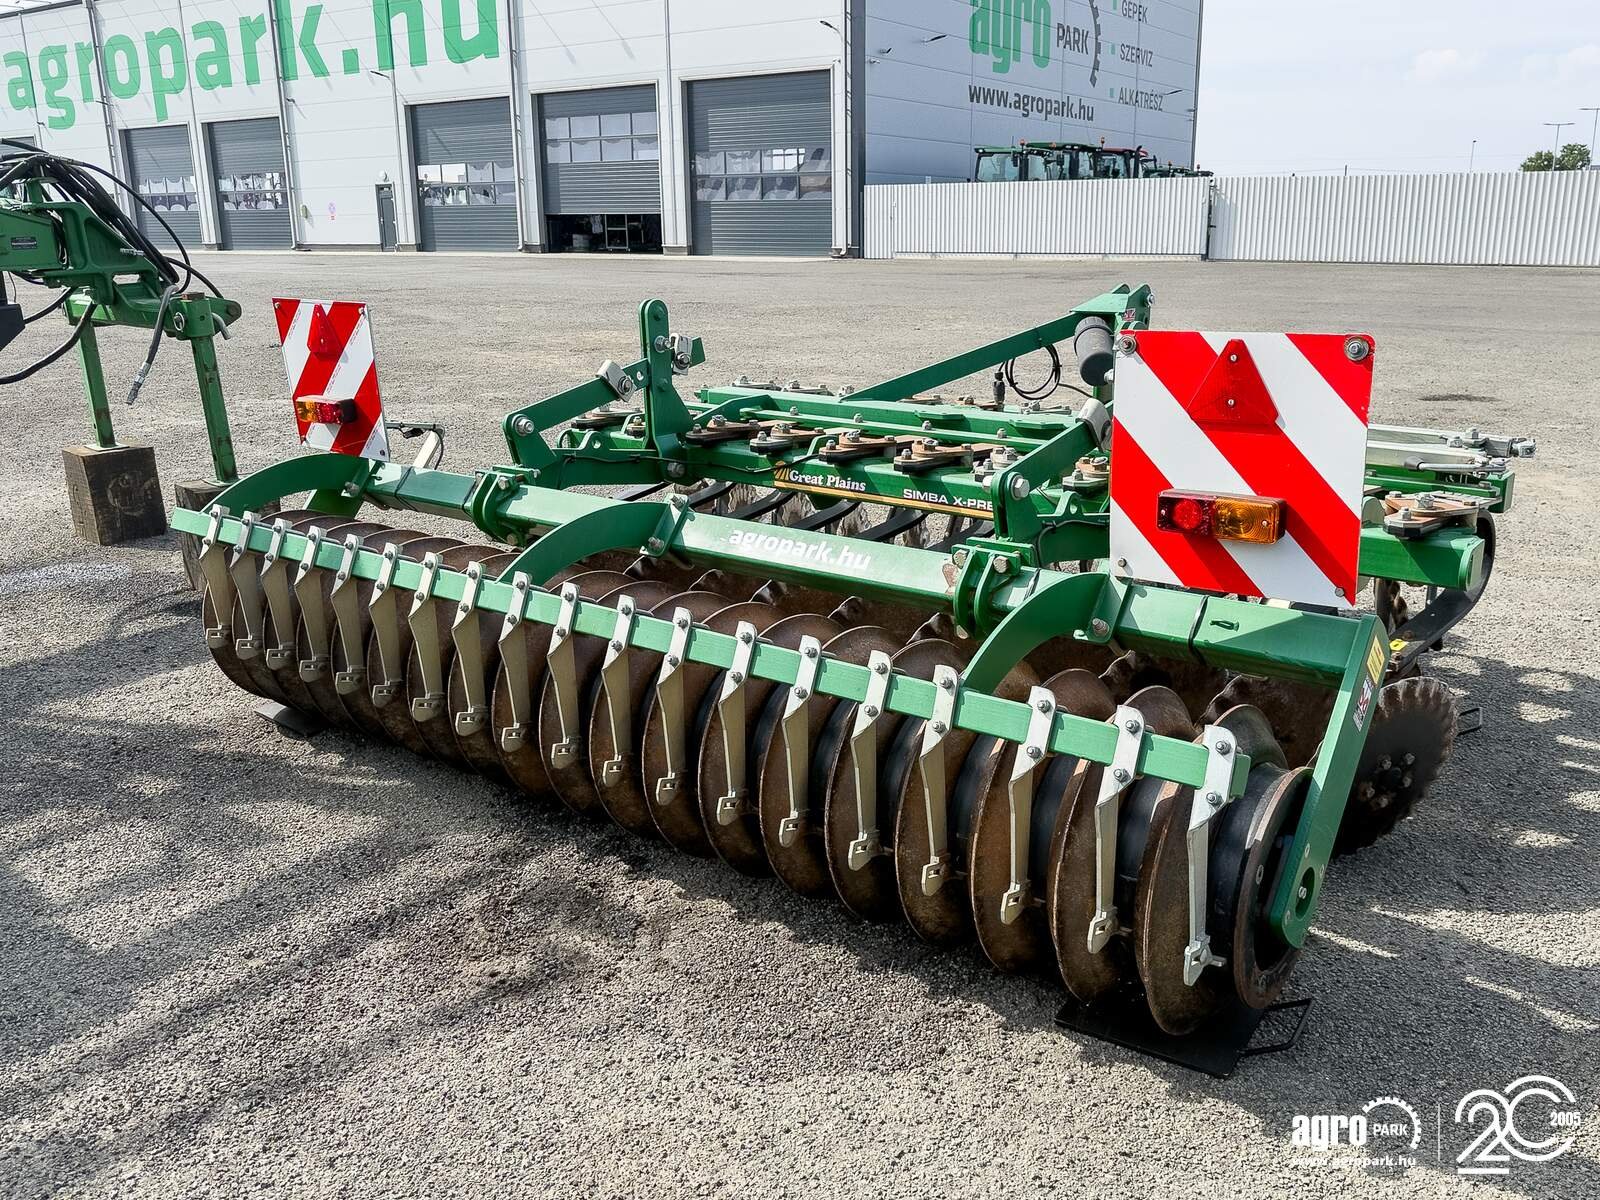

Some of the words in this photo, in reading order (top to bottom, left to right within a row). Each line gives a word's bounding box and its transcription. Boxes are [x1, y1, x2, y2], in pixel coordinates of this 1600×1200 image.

[969, 0, 1051, 74] agro
[1056, 22, 1089, 55] PARK
[3, 0, 500, 130] agropark.hu
[1119, 43, 1153, 67] SZERVIZ
[968, 84, 1094, 122] www.agropark.hu
[1118, 88, 1163, 111] ALKATRÉSZ
[789, 470, 823, 485] Great
[826, 475, 866, 492] Plains
[903, 488, 948, 504] SIMBA
[728, 529, 872, 570] agropark.hu
